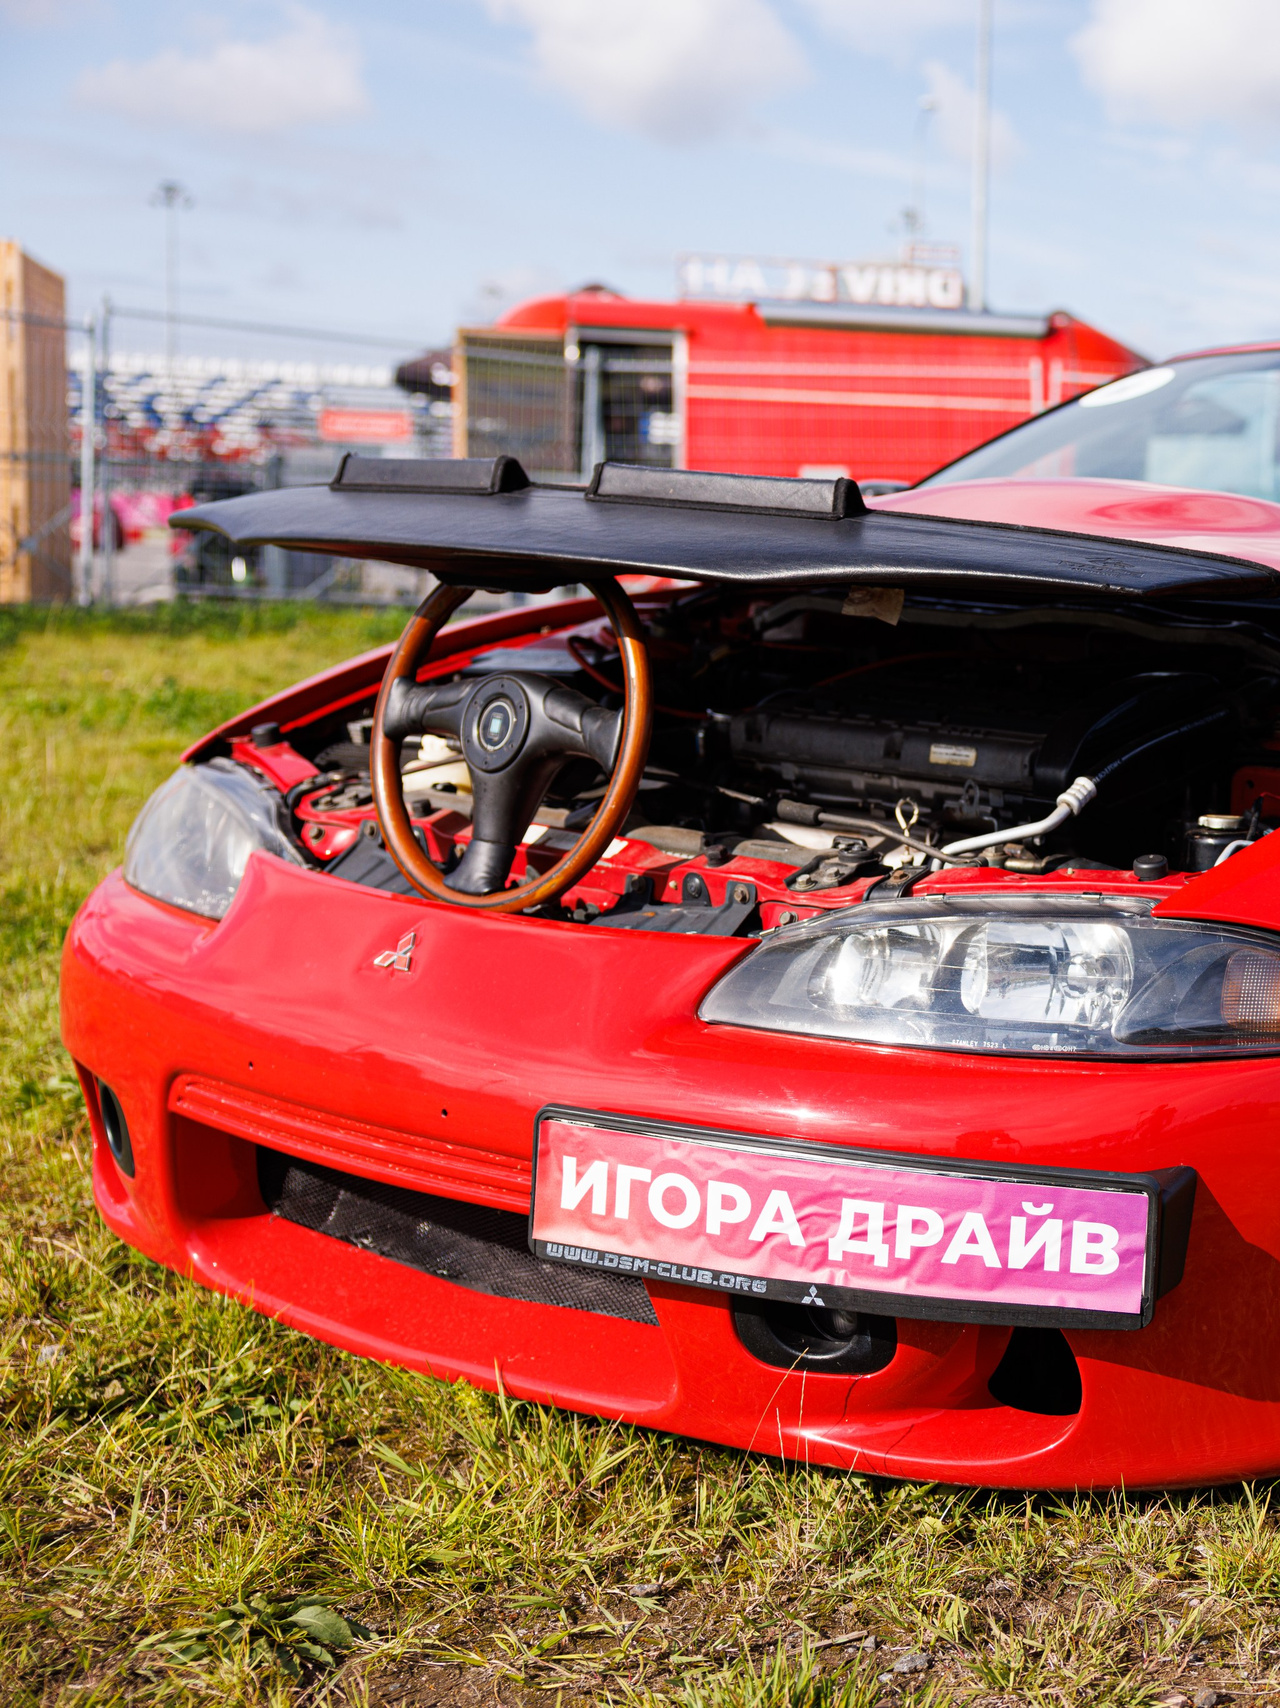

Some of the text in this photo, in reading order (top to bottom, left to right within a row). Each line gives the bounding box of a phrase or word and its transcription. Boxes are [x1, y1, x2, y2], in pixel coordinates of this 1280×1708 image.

[560, 1154, 1121, 1276] ИГОРА ДРАЙВ
[546, 1242, 768, 1294] WWW.DSM-CLUB.ORG
